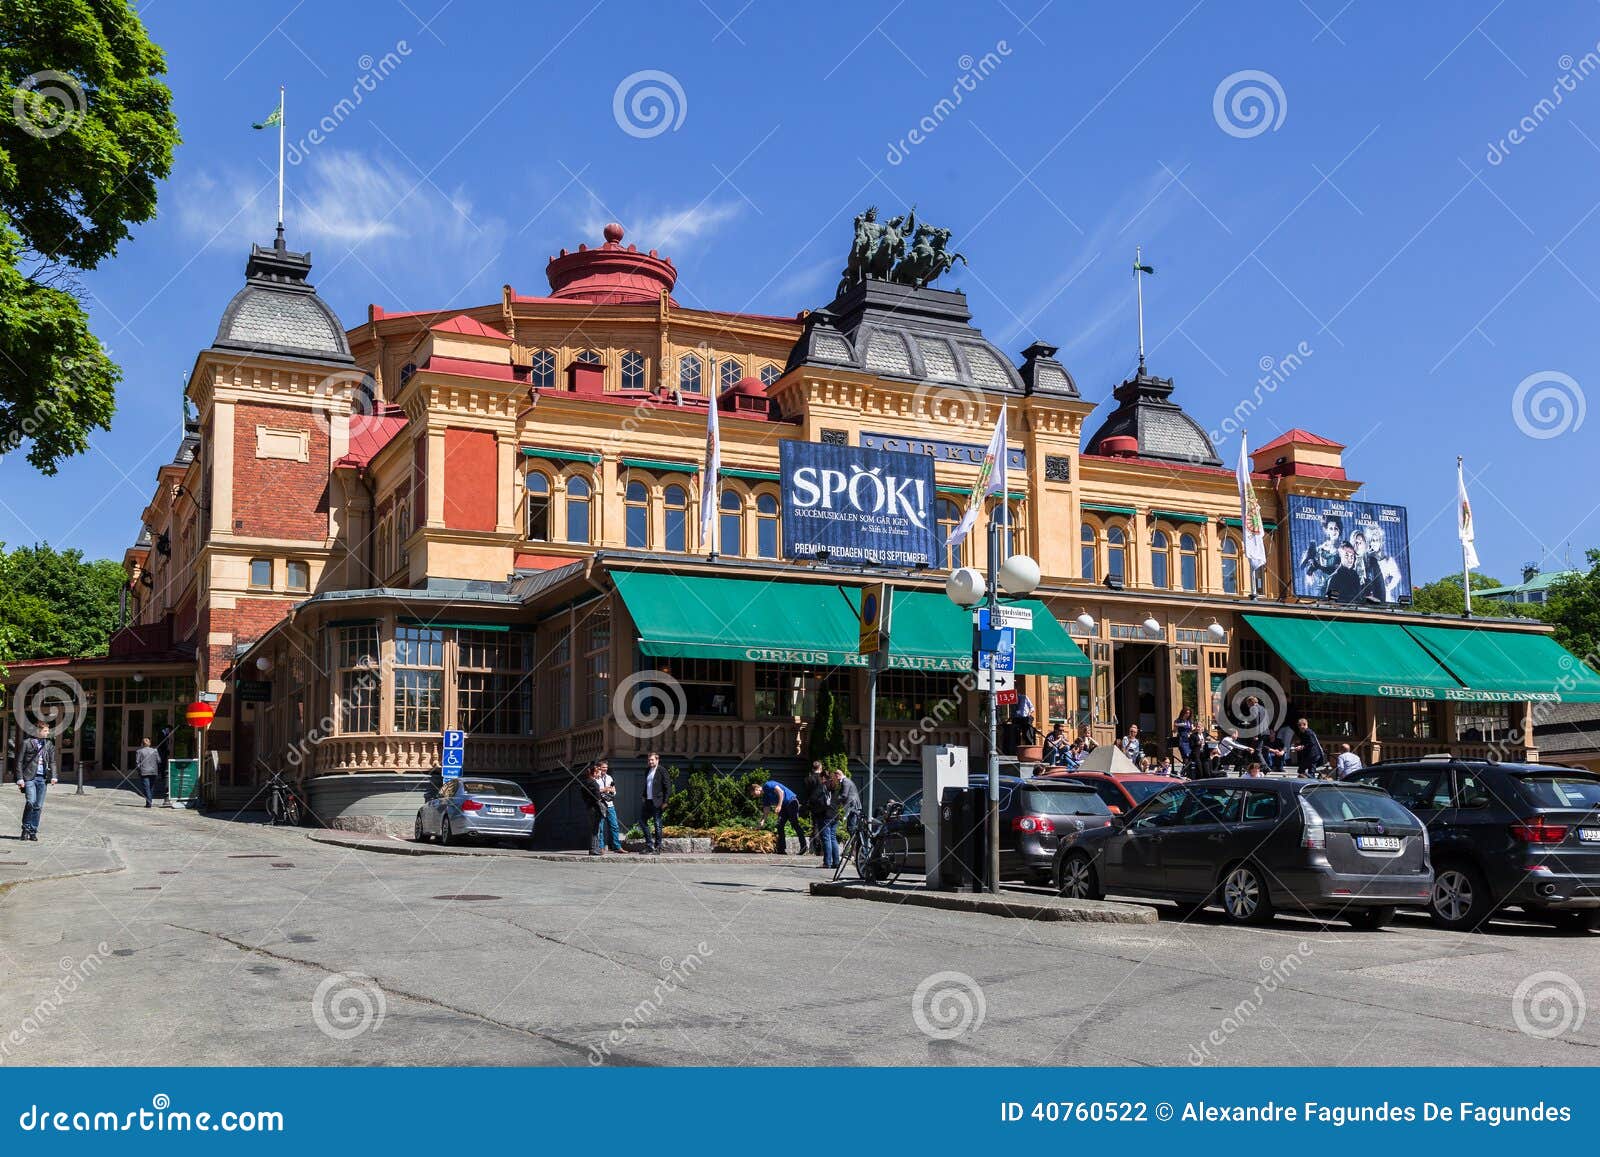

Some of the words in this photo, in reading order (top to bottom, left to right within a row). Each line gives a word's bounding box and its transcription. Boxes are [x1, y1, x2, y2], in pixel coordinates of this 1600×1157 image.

[882, 440, 985, 463] CIRKU
[860, 514, 875, 524] SOM
[893, 517, 909, 526] IGEN
[864, 548, 878, 560] DEN
[879, 549, 885, 560] 13
[746, 648, 829, 664] CIRKUS
[1377, 685, 1435, 698] CIRKUS
[1445, 689, 1562, 702] RESTAURANGEN
[449, 732, 460, 747] P
